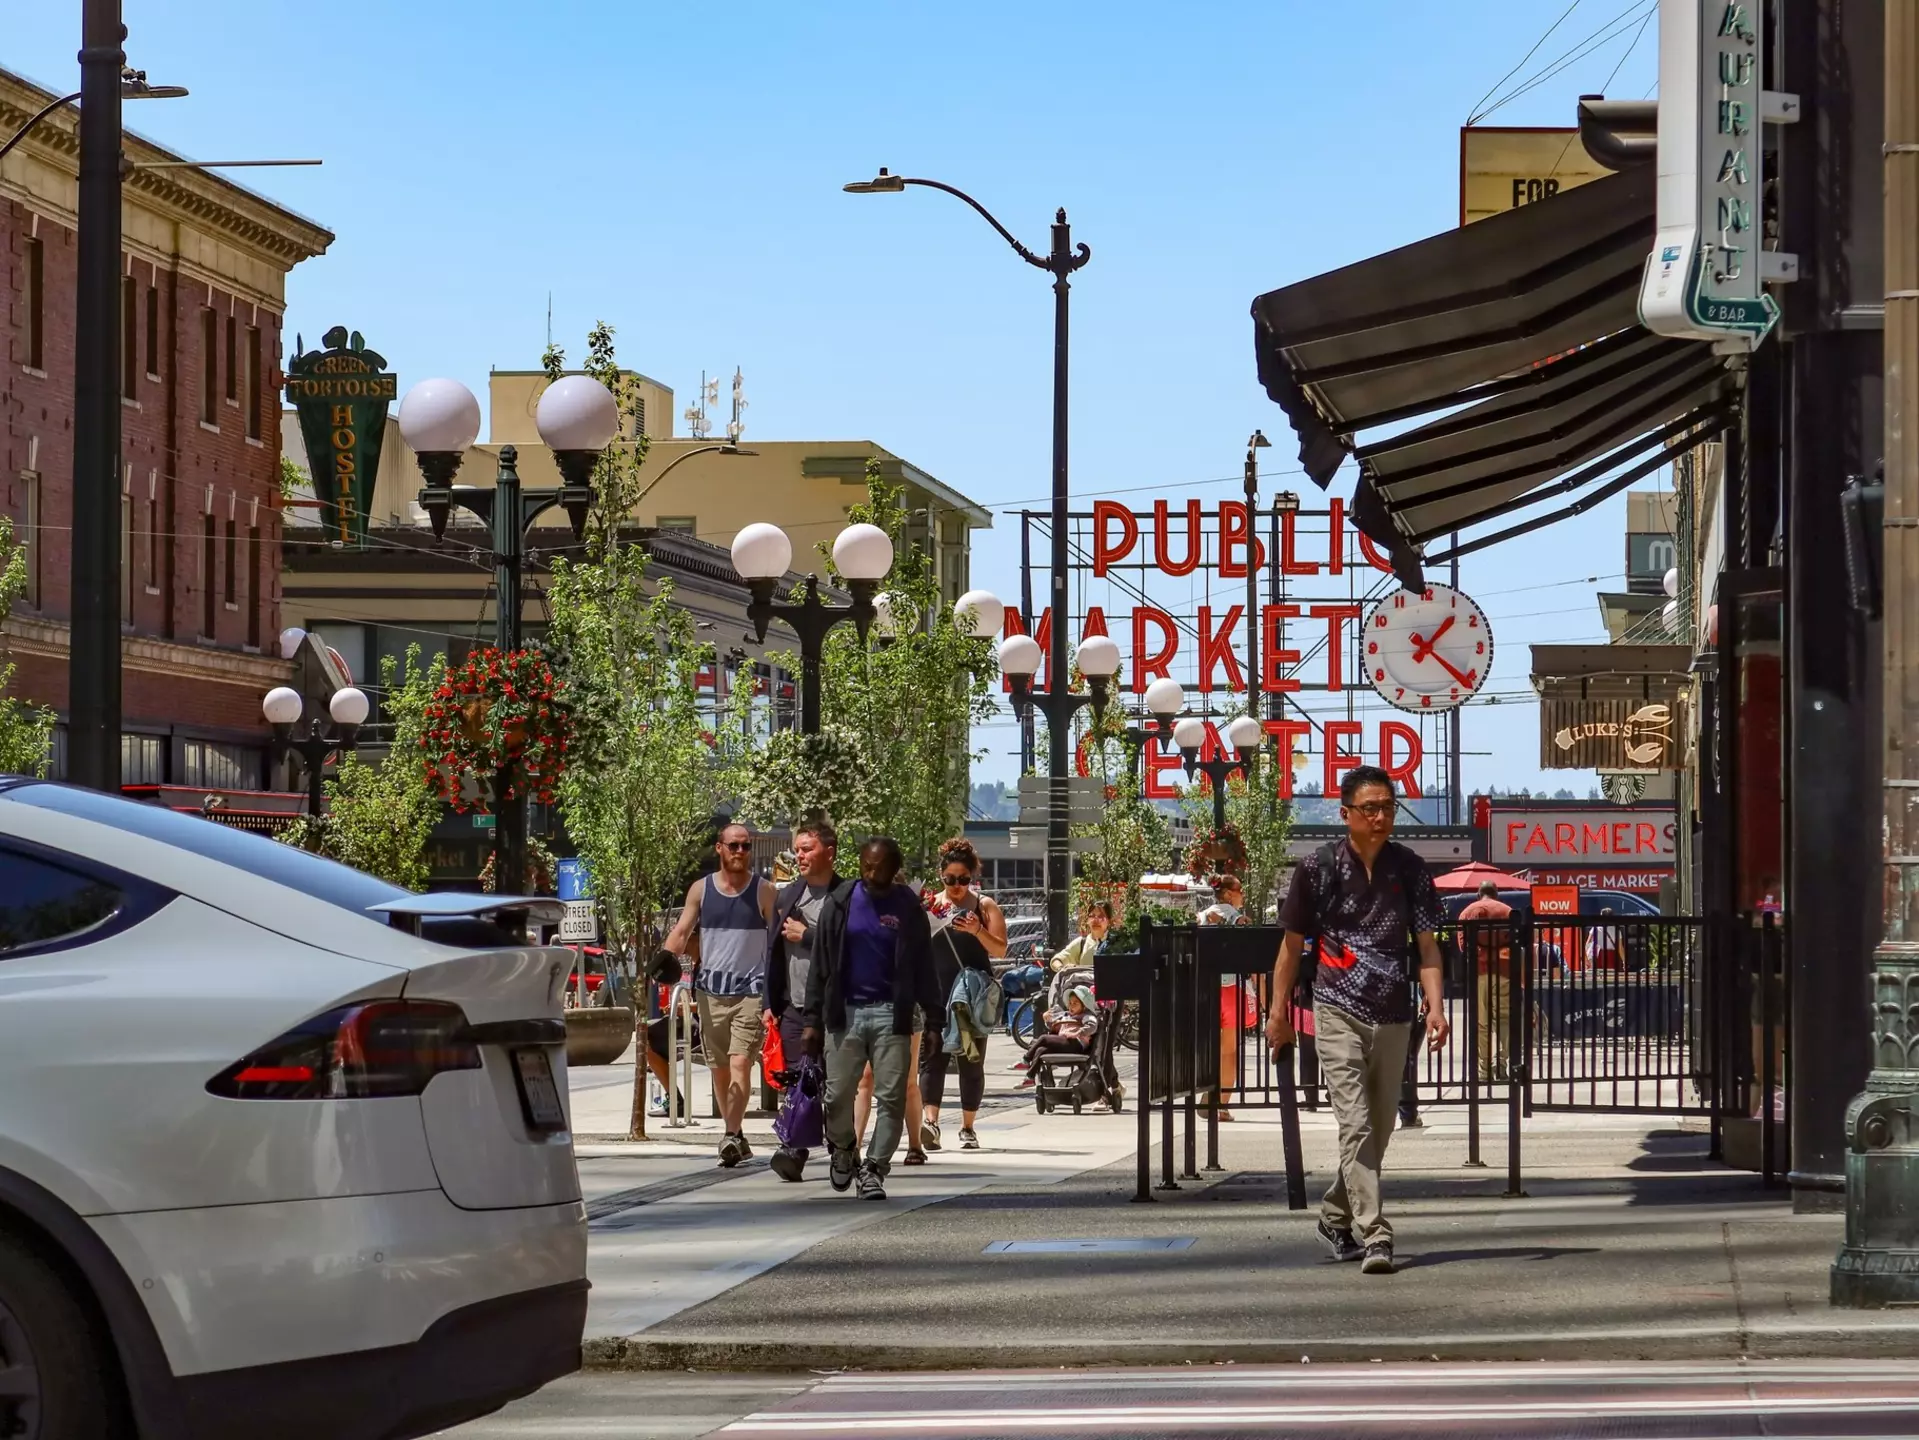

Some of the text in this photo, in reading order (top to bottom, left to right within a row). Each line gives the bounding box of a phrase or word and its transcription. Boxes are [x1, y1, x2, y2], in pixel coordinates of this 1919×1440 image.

[1708, 305, 1746, 322] & BAR
[313, 356, 371, 375] GREEN
[289, 378, 395, 398] TORTOISE
[331, 404, 358, 543] HOSTEL
[1394, 595, 1405, 608] 11
[1375, 615, 1388, 627] 10
[1468, 615, 1478, 628] 2
[1368, 641, 1378, 655] 9
[1475, 641, 1484, 655] 3
[1375, 668, 1385, 682] 8
[1395, 688, 1405, 701] 7
[1450, 687, 1459, 700] 5
[1421, 695, 1431, 708] 6
[1572, 722, 1633, 741] LUKE'S
[1507, 823, 1676, 855] FARMERS
[1540, 900, 1571, 911] NOW
[563, 920, 593, 934] CLOSED
